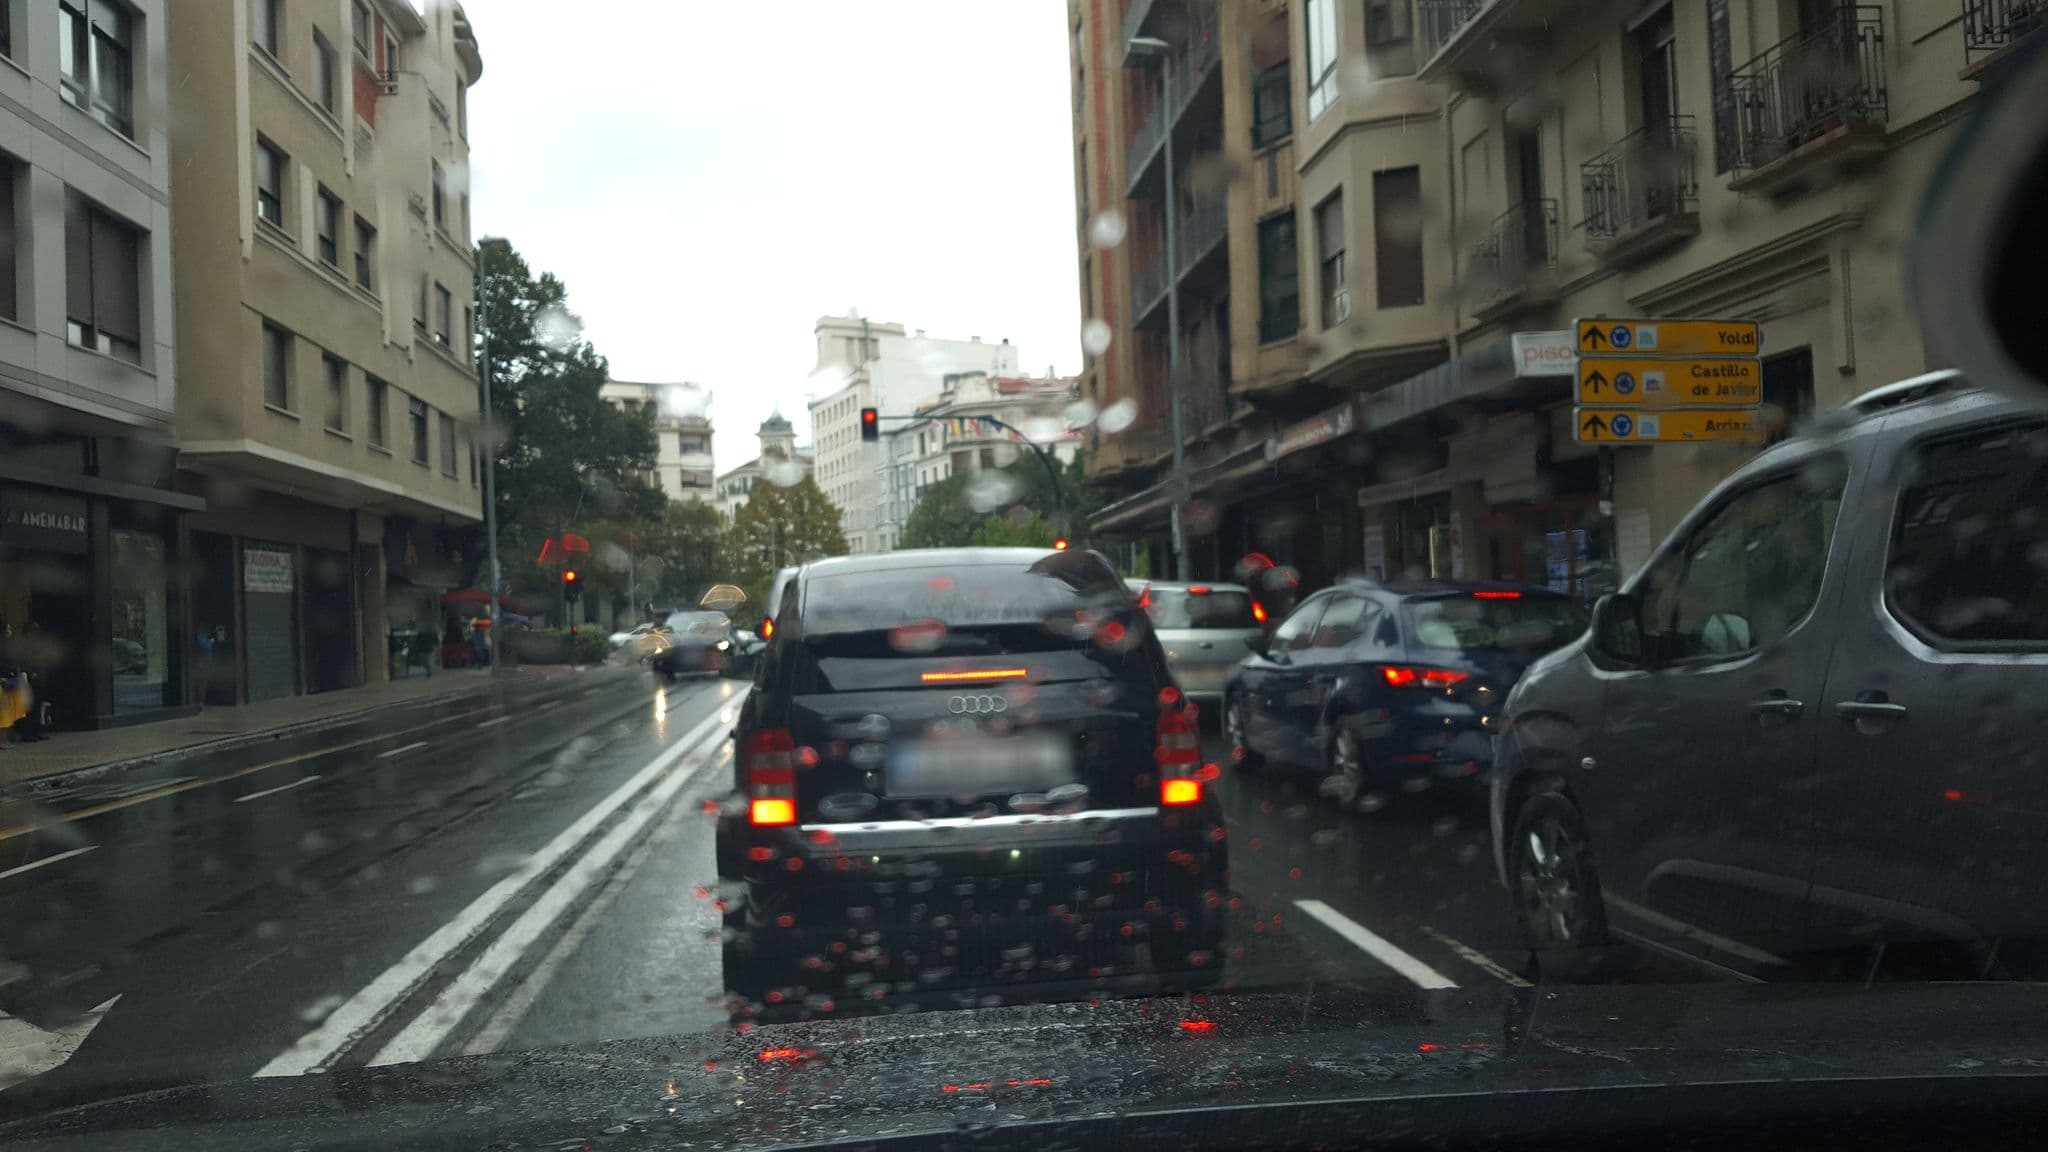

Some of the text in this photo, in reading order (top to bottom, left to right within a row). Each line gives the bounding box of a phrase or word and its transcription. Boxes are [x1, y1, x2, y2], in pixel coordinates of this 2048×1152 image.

[1718, 329, 1755, 345] Yoldi
[1691, 363, 1749, 378] Castillo
[1692, 383, 1709, 396] de
